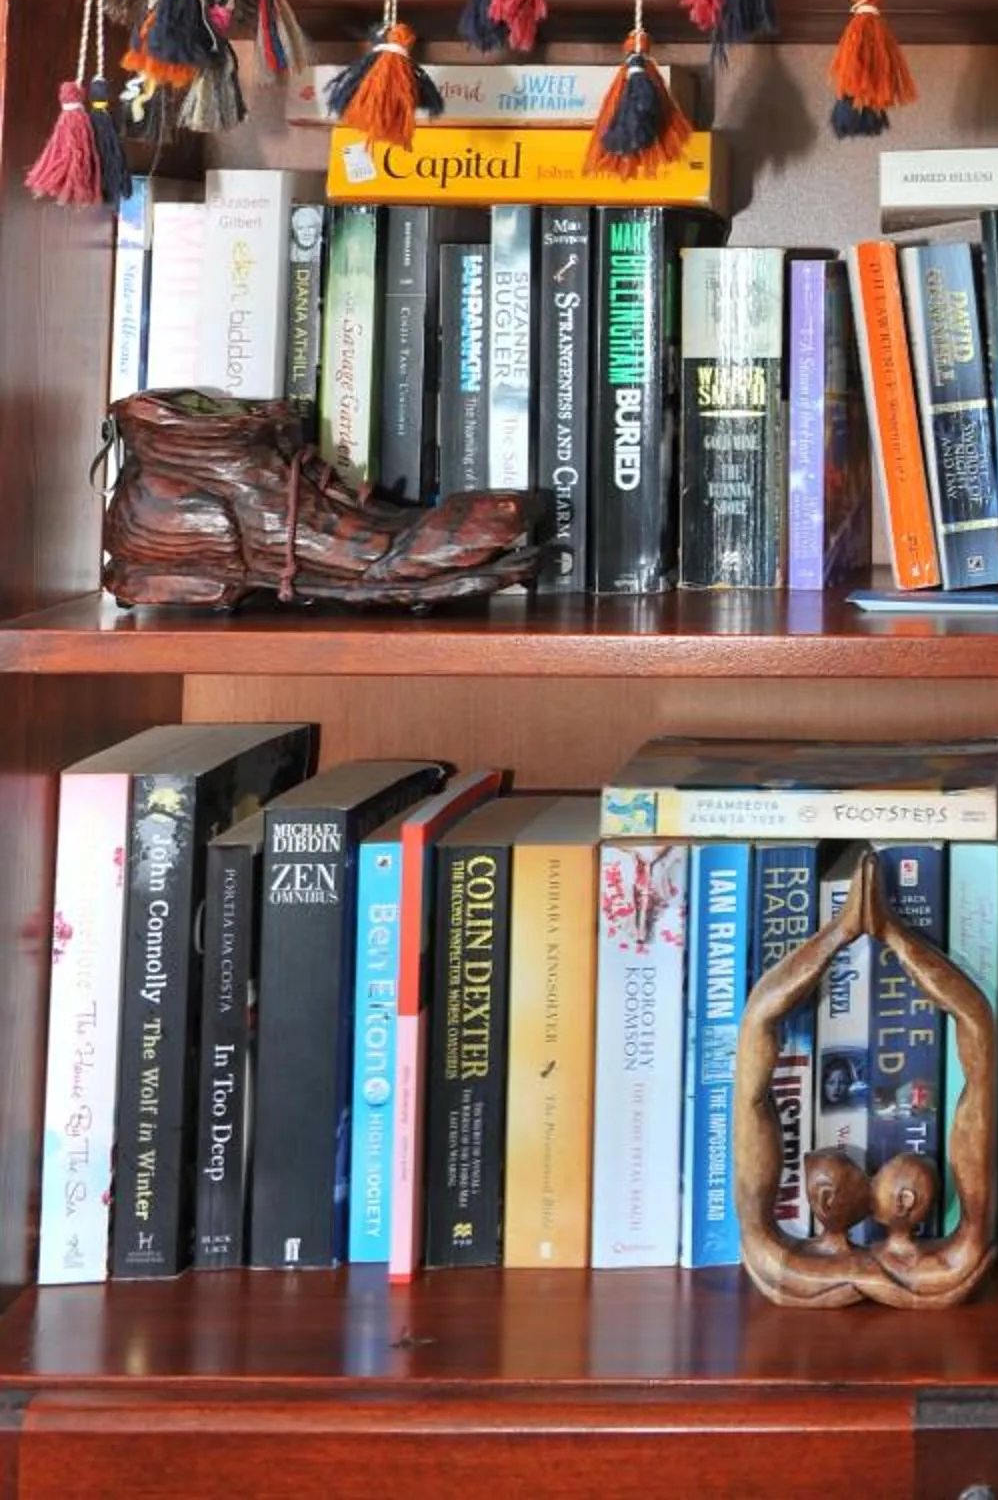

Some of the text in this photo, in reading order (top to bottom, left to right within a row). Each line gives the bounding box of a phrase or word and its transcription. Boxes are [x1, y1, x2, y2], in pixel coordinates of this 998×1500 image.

[383, 141, 521, 188] Capital
[226, 311, 256, 389] bidden
[293, 268, 311, 382] DIANA ATHILL
[461, 255, 482, 391] IAN RANKIN
[494, 271, 512, 378] BUGLER
[513, 271, 529, 378] SUZANNE
[553, 291, 580, 540] STRANGENESS AND CHARM
[608, 255, 651, 490] BILLINGHAM BURIED
[461, 422, 477, 467] Naming
[271, 836, 342, 853] DIBDIN
[272, 823, 342, 836] MICHAEL
[834, 803, 948, 823] FOOTSTEPS
[269, 892, 339, 904] OMNIBUS
[271, 864, 339, 891] ZEN
[464, 855, 496, 950] COLIN
[709, 869, 737, 914] IAN
[220, 868, 237, 1013] PORTIA DA COSTA
[544, 859, 562, 1044] BARBARA KINGSOLVER
[706, 923, 736, 1018] RANKIN
[134, 833, 173, 1221] John Connolly The Wolf in Winter
[462, 961, 494, 1080] DEXTER
[622, 966, 641, 1071] KOOMSON
[637, 966, 656, 1068] DOROTHY
[830, 970, 853, 1019] STEEL
[878, 950, 906, 1074] CHILD
[205, 1044, 235, 1182] In Too Deep
[365, 903, 399, 1237] Ben Elton HIGH SOCIETY
[709, 1087, 728, 1109] THE
[708, 1113, 727, 1186] IMPOSSIBLE
[706, 1189, 726, 1221] DEAD
